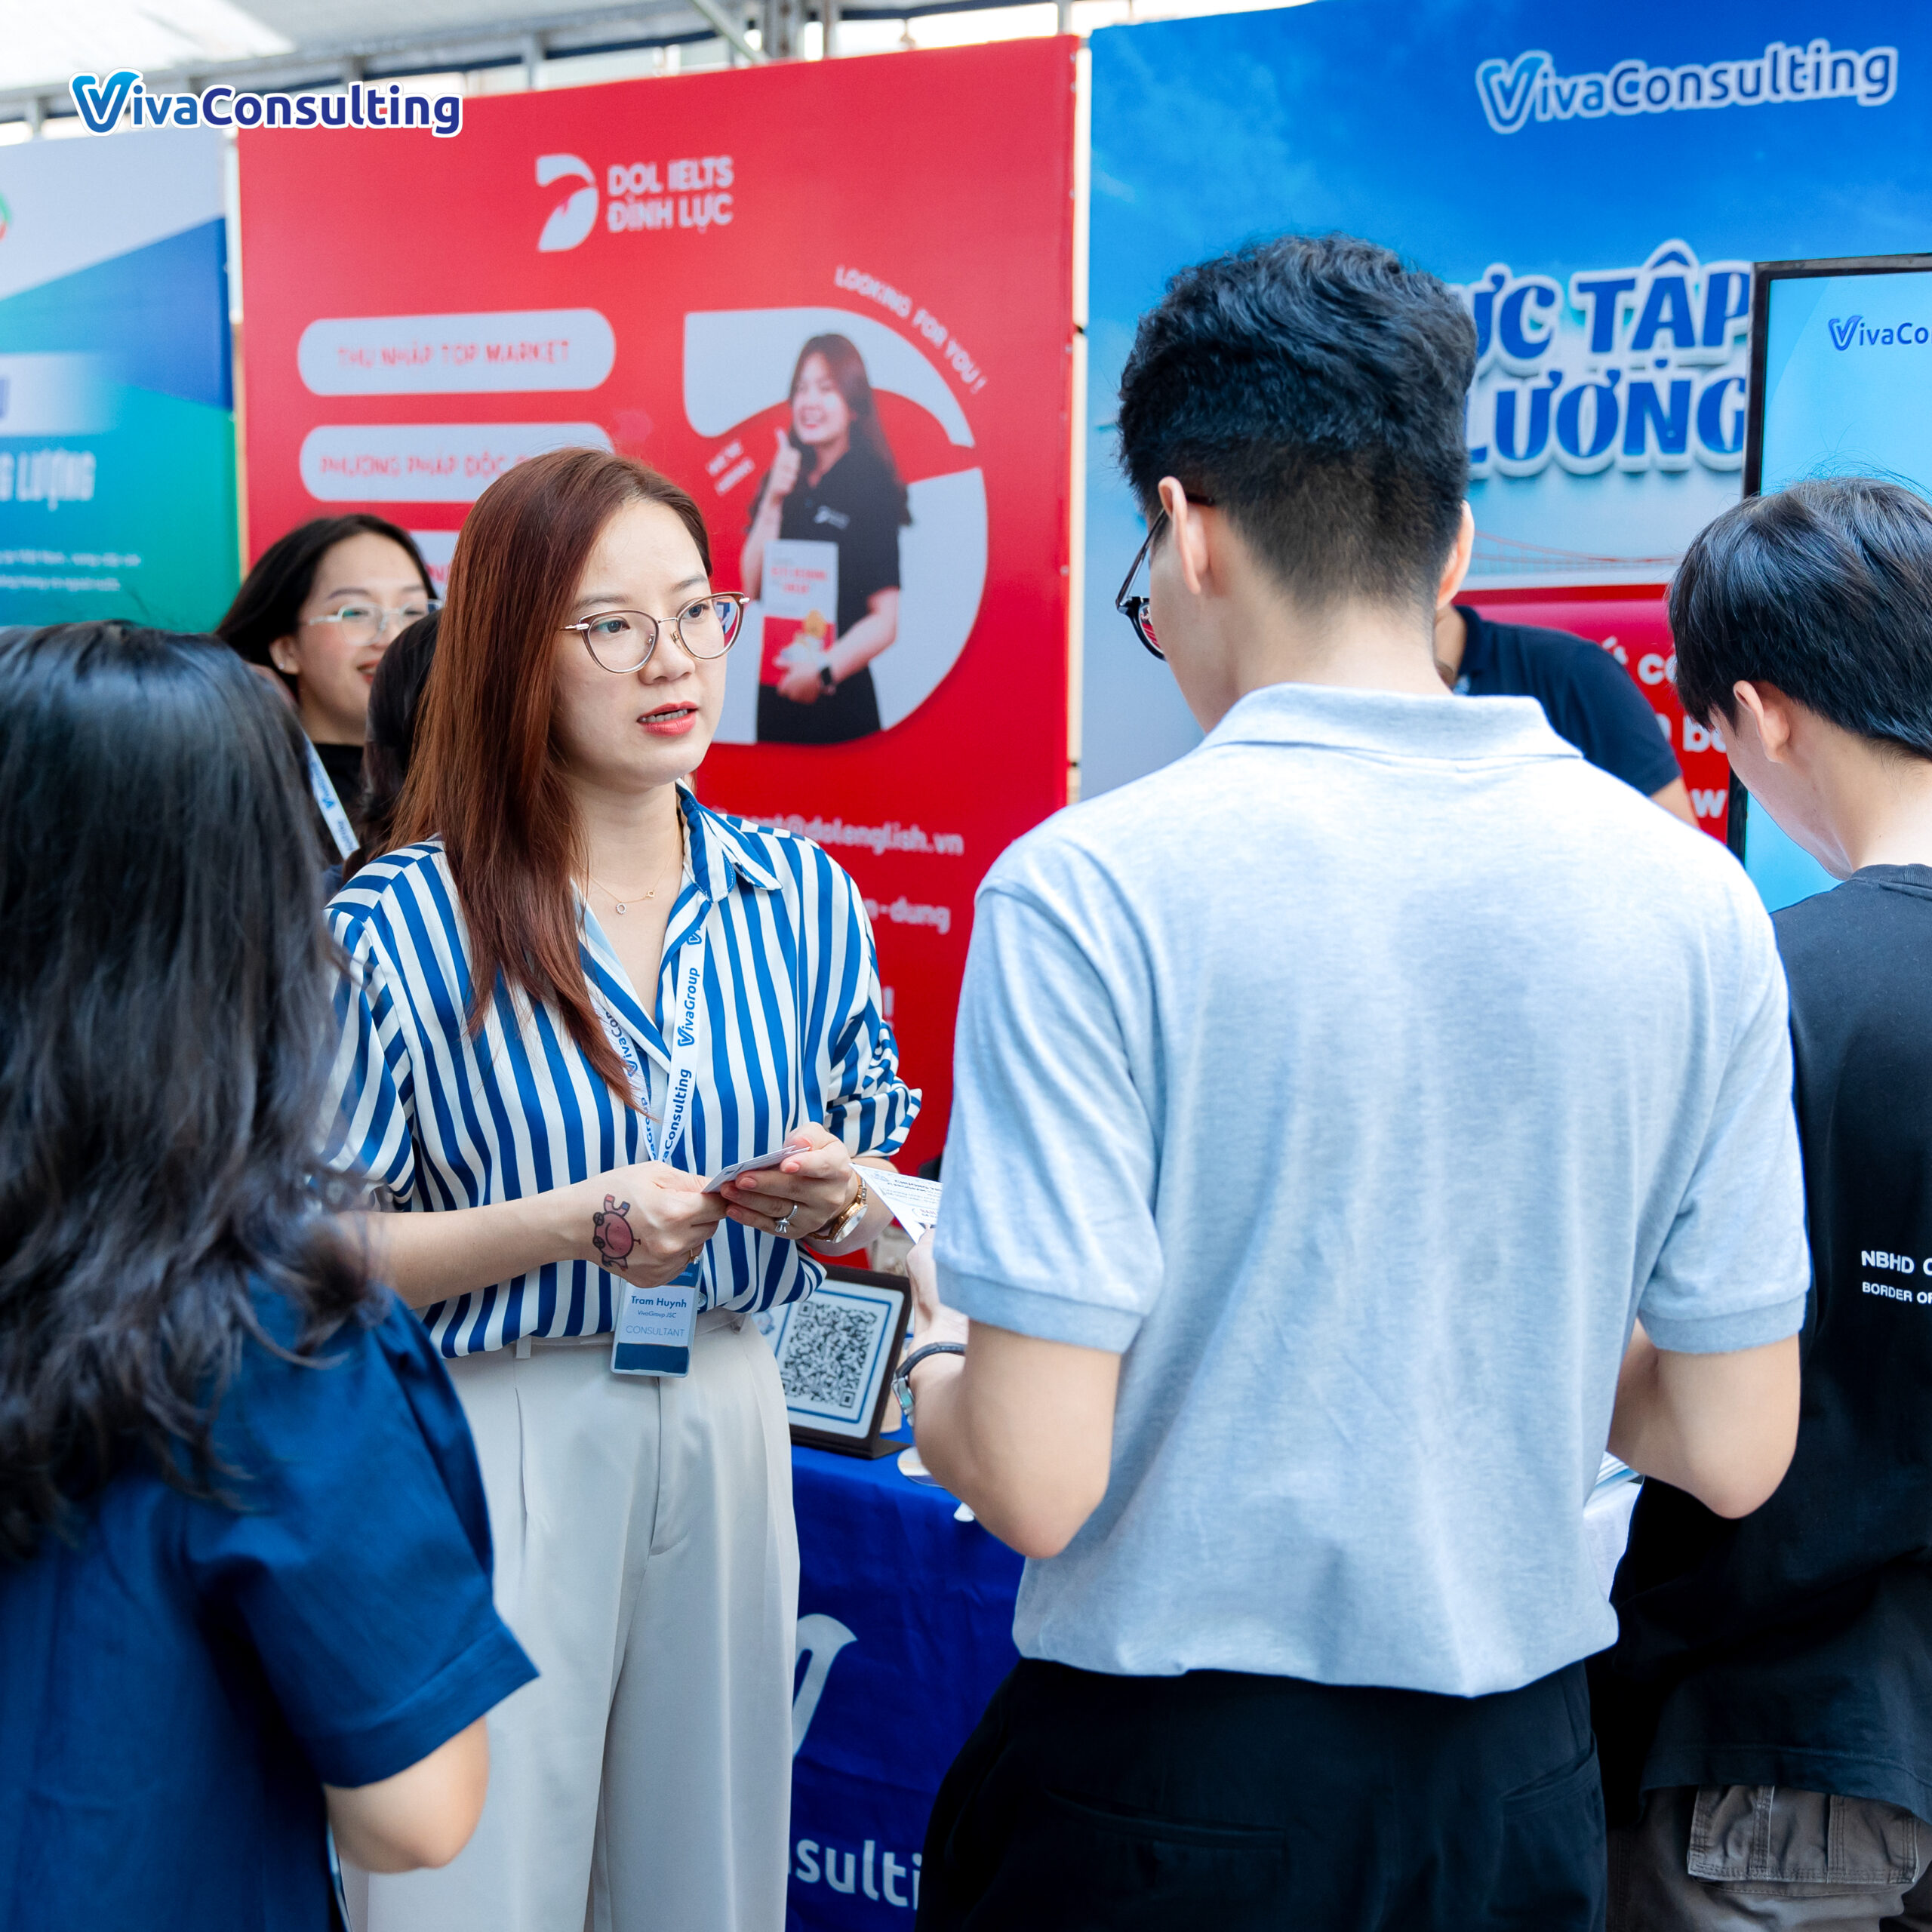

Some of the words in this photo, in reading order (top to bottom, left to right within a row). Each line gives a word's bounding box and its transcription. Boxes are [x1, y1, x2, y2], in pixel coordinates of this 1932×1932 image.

[1477, 39, 1898, 134] VivaConsulting
[667, 155, 734, 192] IELTS
[1828, 315, 1932, 352] VivaCo
[677, 967, 700, 1048] VivaGroup
[663, 1068, 692, 1163] aConsulting
[1860, 1250, 1915, 1275] NBHD
[631, 1295, 654, 1306] Tram
[657, 1297, 687, 1309] Huynh
[1861, 1281, 1913, 1303] BORDER
[625, 1324, 685, 1337] CONSULTANT
[638, 1309, 666, 1318] VivaGroup
[795, 1838, 922, 1911] sulti
